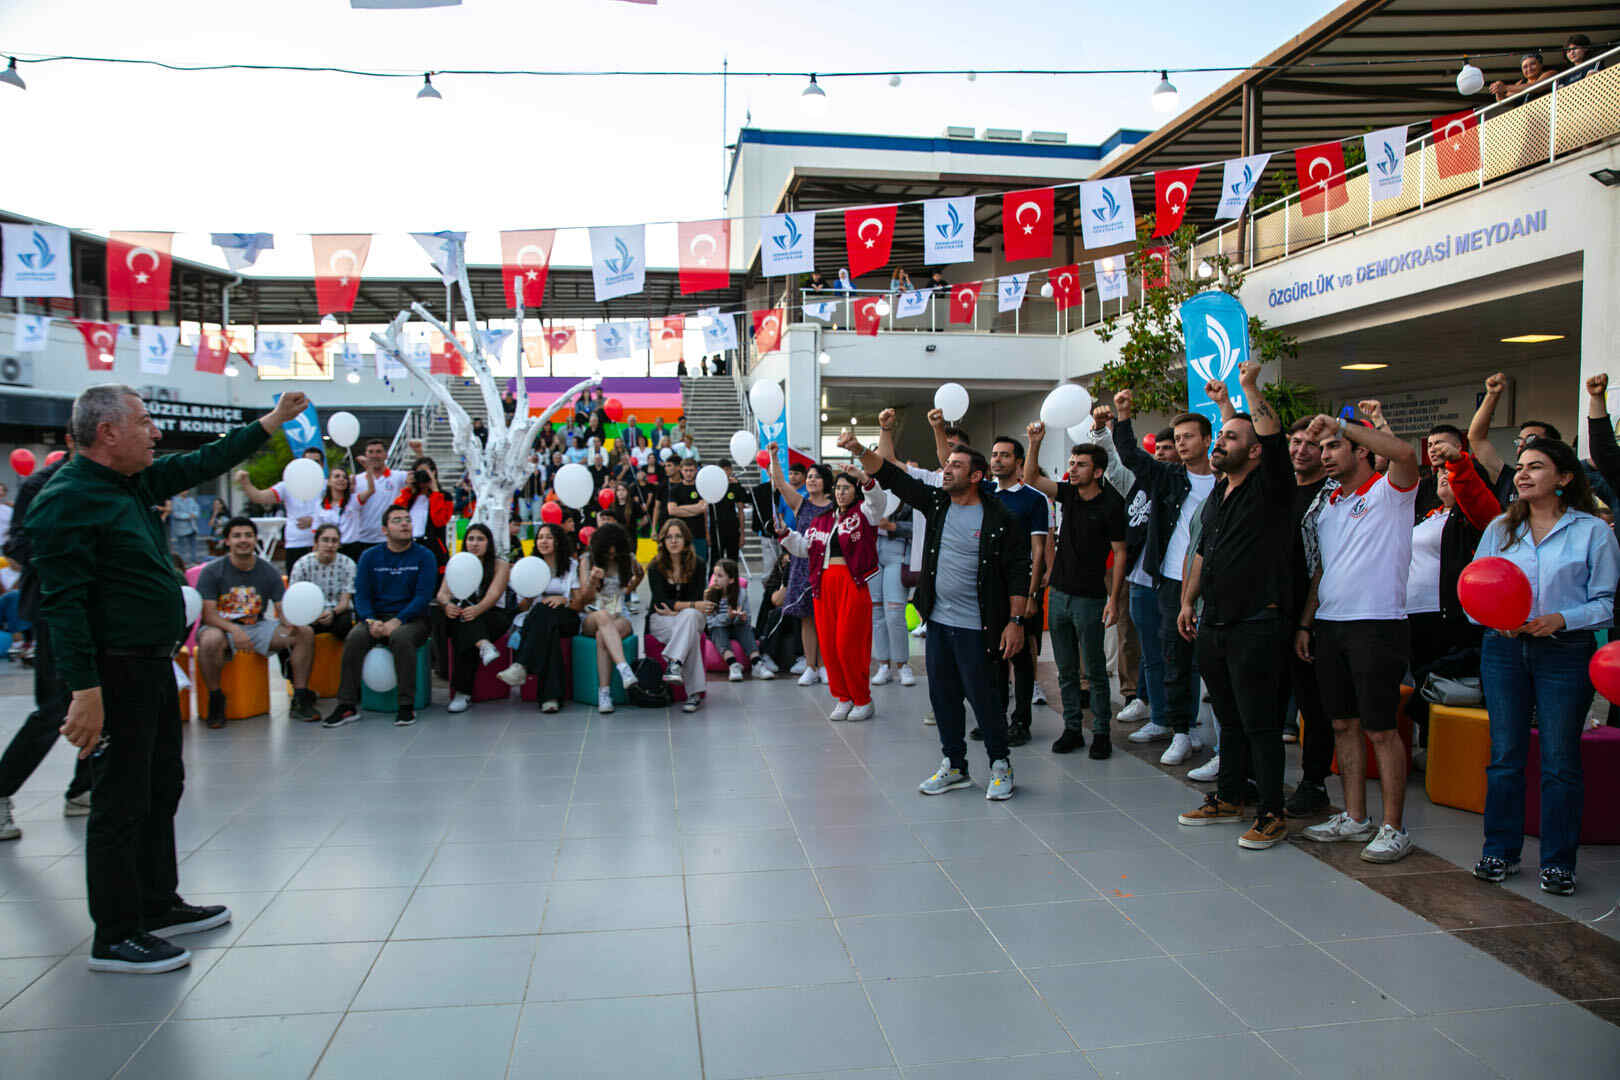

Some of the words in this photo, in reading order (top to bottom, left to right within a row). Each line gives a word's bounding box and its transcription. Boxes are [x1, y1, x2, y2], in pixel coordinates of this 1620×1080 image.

[1268, 273, 1335, 308] ÖZGÜRLÜK
[1355, 234, 1451, 284] DEMOKRASİ
[1454, 208, 1547, 256] MEYDANI
